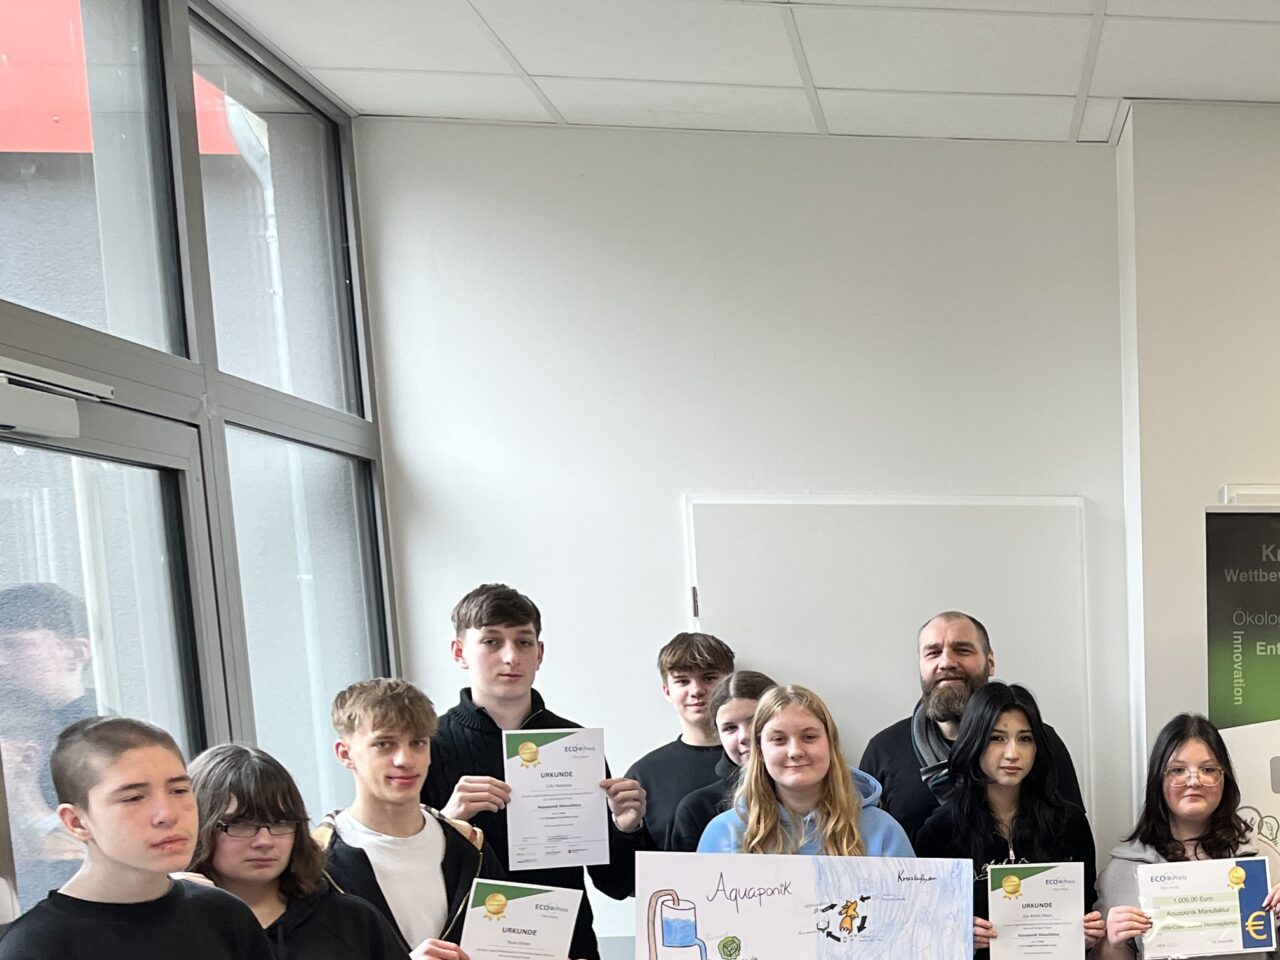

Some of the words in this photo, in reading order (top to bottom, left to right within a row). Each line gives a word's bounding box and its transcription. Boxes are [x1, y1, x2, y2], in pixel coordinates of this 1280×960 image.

[1232, 630, 1243, 705] Innovation
[502, 927, 537, 936] URKUNDE
[1245, 911, 1268, 940] €
